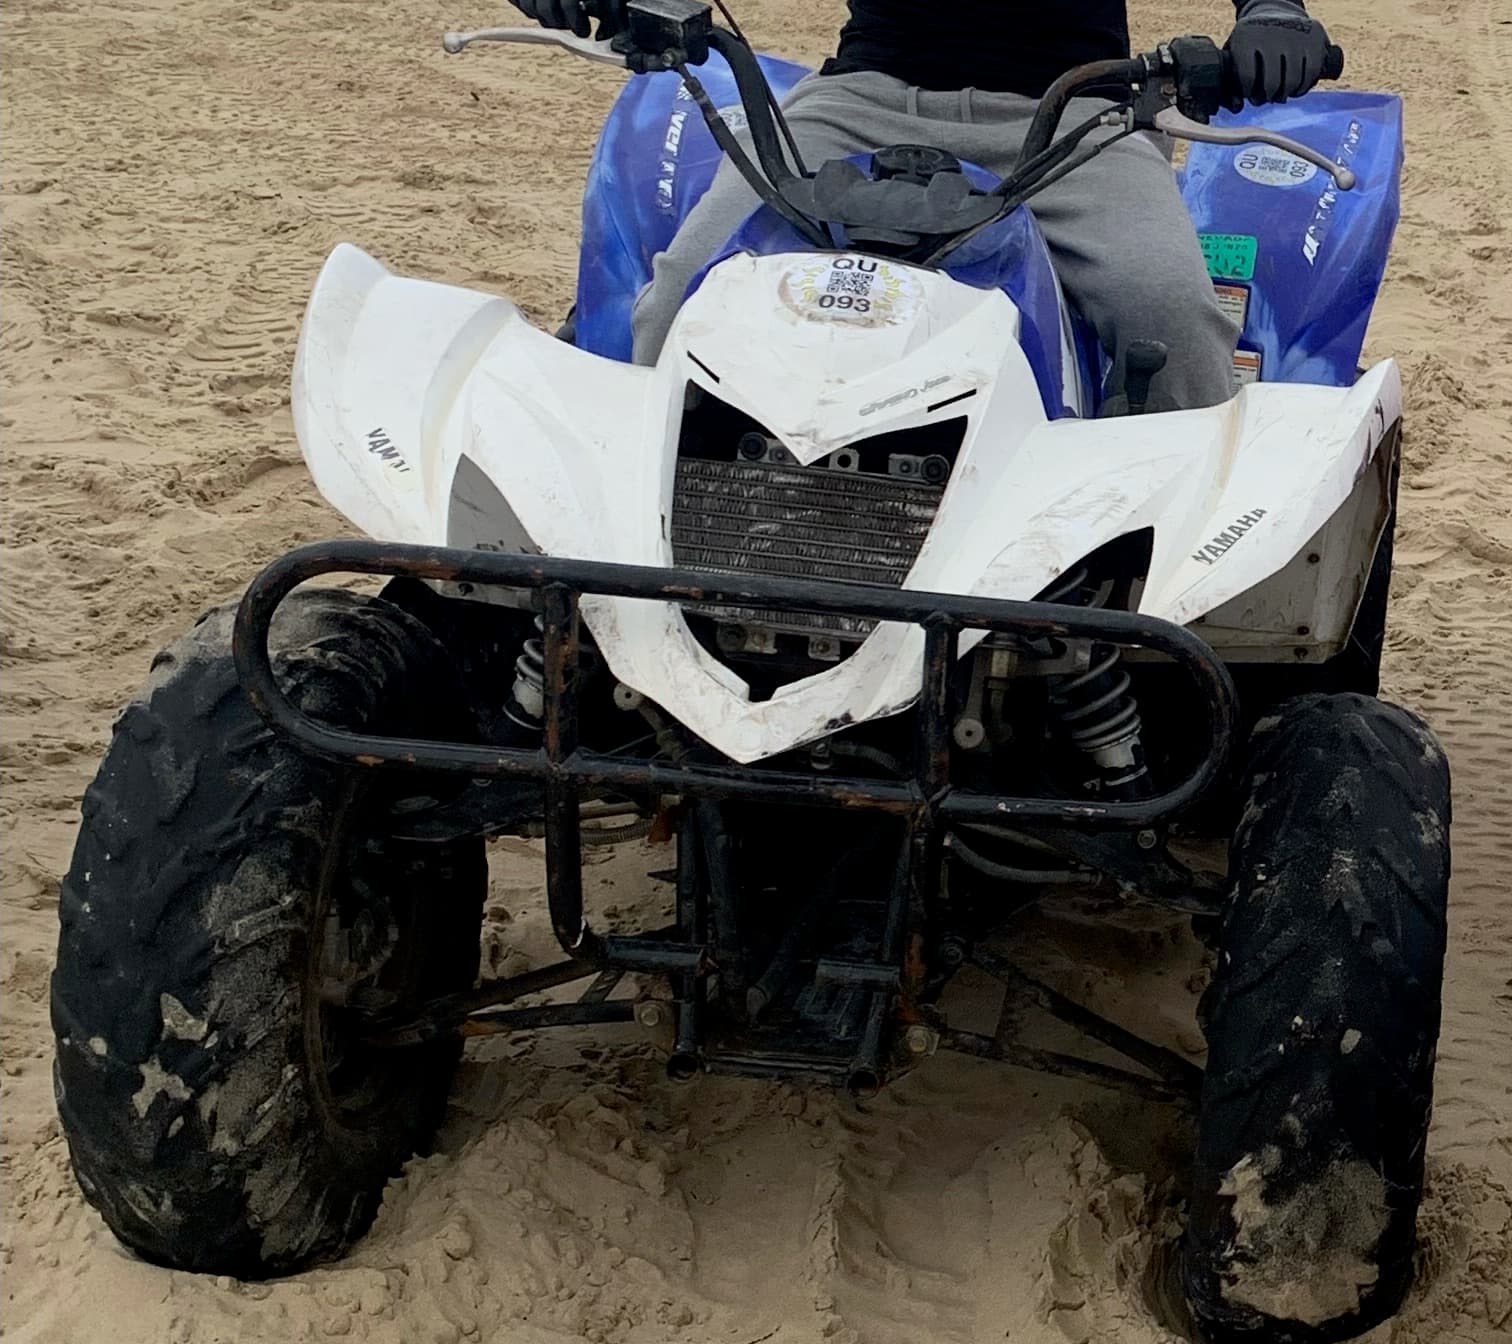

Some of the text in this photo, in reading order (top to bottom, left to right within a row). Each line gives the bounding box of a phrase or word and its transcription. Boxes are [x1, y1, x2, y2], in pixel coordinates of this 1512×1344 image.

[832, 258, 878, 273] QU
[818, 294, 871, 313] 093
[1191, 508, 1267, 565] YAMAHA
